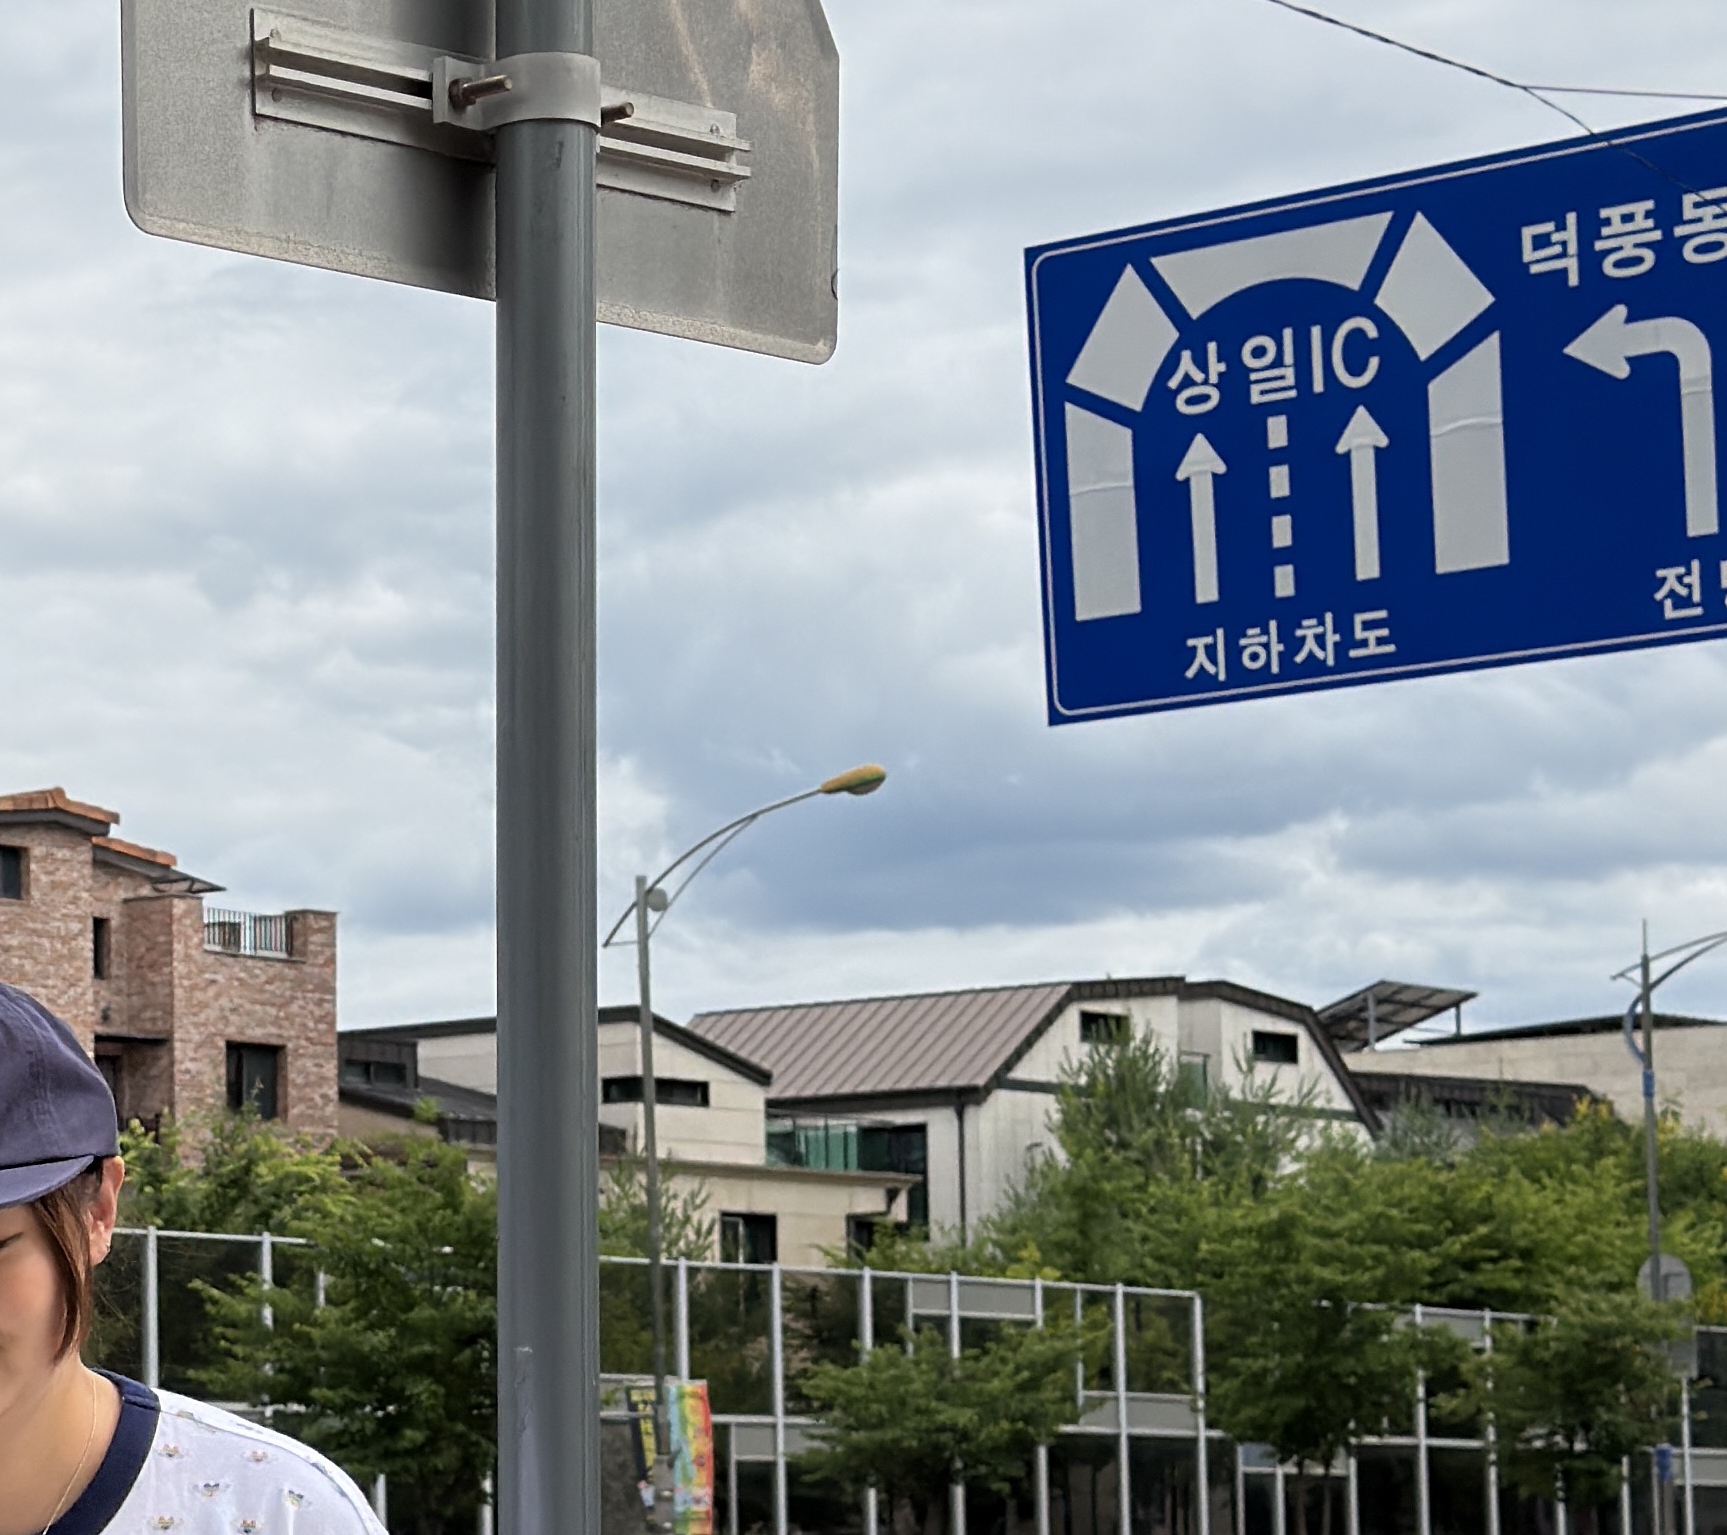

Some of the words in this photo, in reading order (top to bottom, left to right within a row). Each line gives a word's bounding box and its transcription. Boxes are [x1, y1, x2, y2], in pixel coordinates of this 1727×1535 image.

[1521, 186, 1727, 287] 덕풍동
[1166, 315, 1381, 417] 상일IC
[1653, 558, 1727, 620] 전
[1184, 608, 1397, 682] 지하차도
